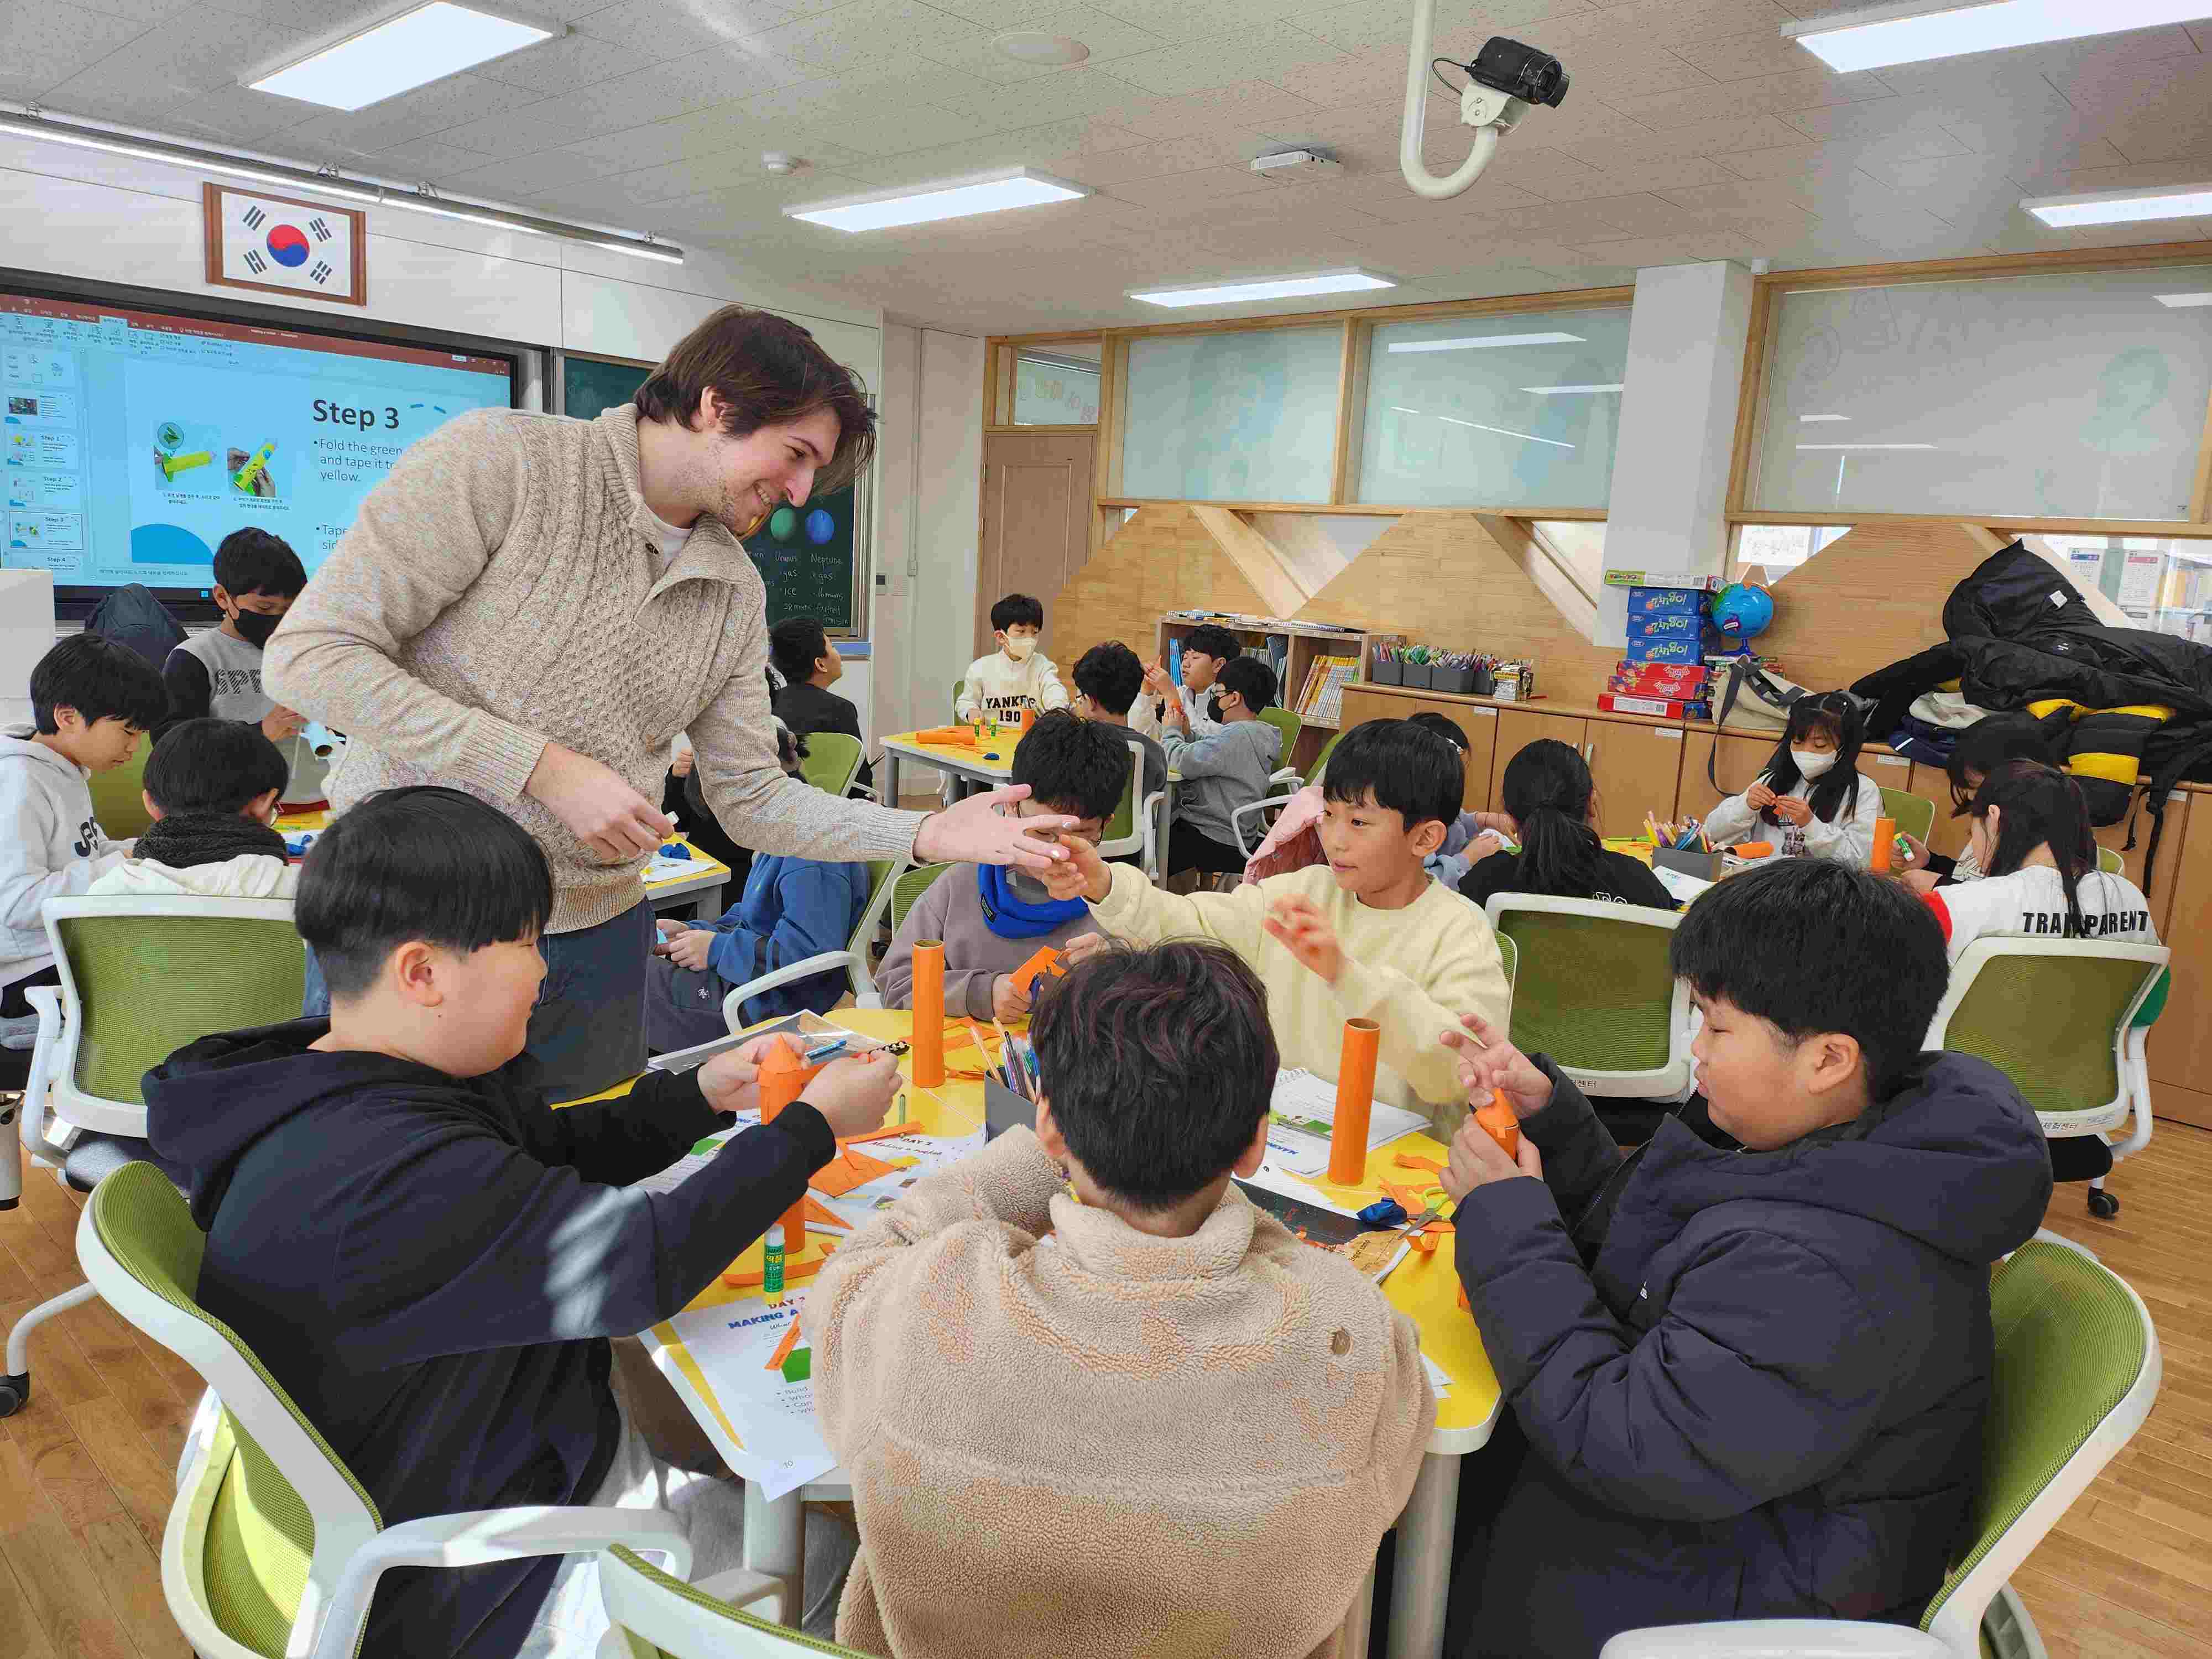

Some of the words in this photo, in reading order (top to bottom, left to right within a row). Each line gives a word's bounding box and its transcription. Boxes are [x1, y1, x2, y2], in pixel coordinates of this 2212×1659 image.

[313, 399, 375, 431] Step
[384, 407, 399, 429] 3
[319, 438, 344, 451] Fold
[348, 442, 367, 452] the
[370, 445, 403, 456] green
[320, 455, 342, 465] and
[346, 458, 372, 469] tape
[374, 460, 383, 468] it
[320, 469, 361, 482] yellow.
[985, 695, 1036, 709] YANKS
[2022, 910, 2149, 937] TRAPARENT
[1575, 1079, 1597, 1089] 센터
[768, 1298, 794, 1309] DAY
[728, 1312, 784, 1329] MAKING
[790, 1308, 799, 1317] A
